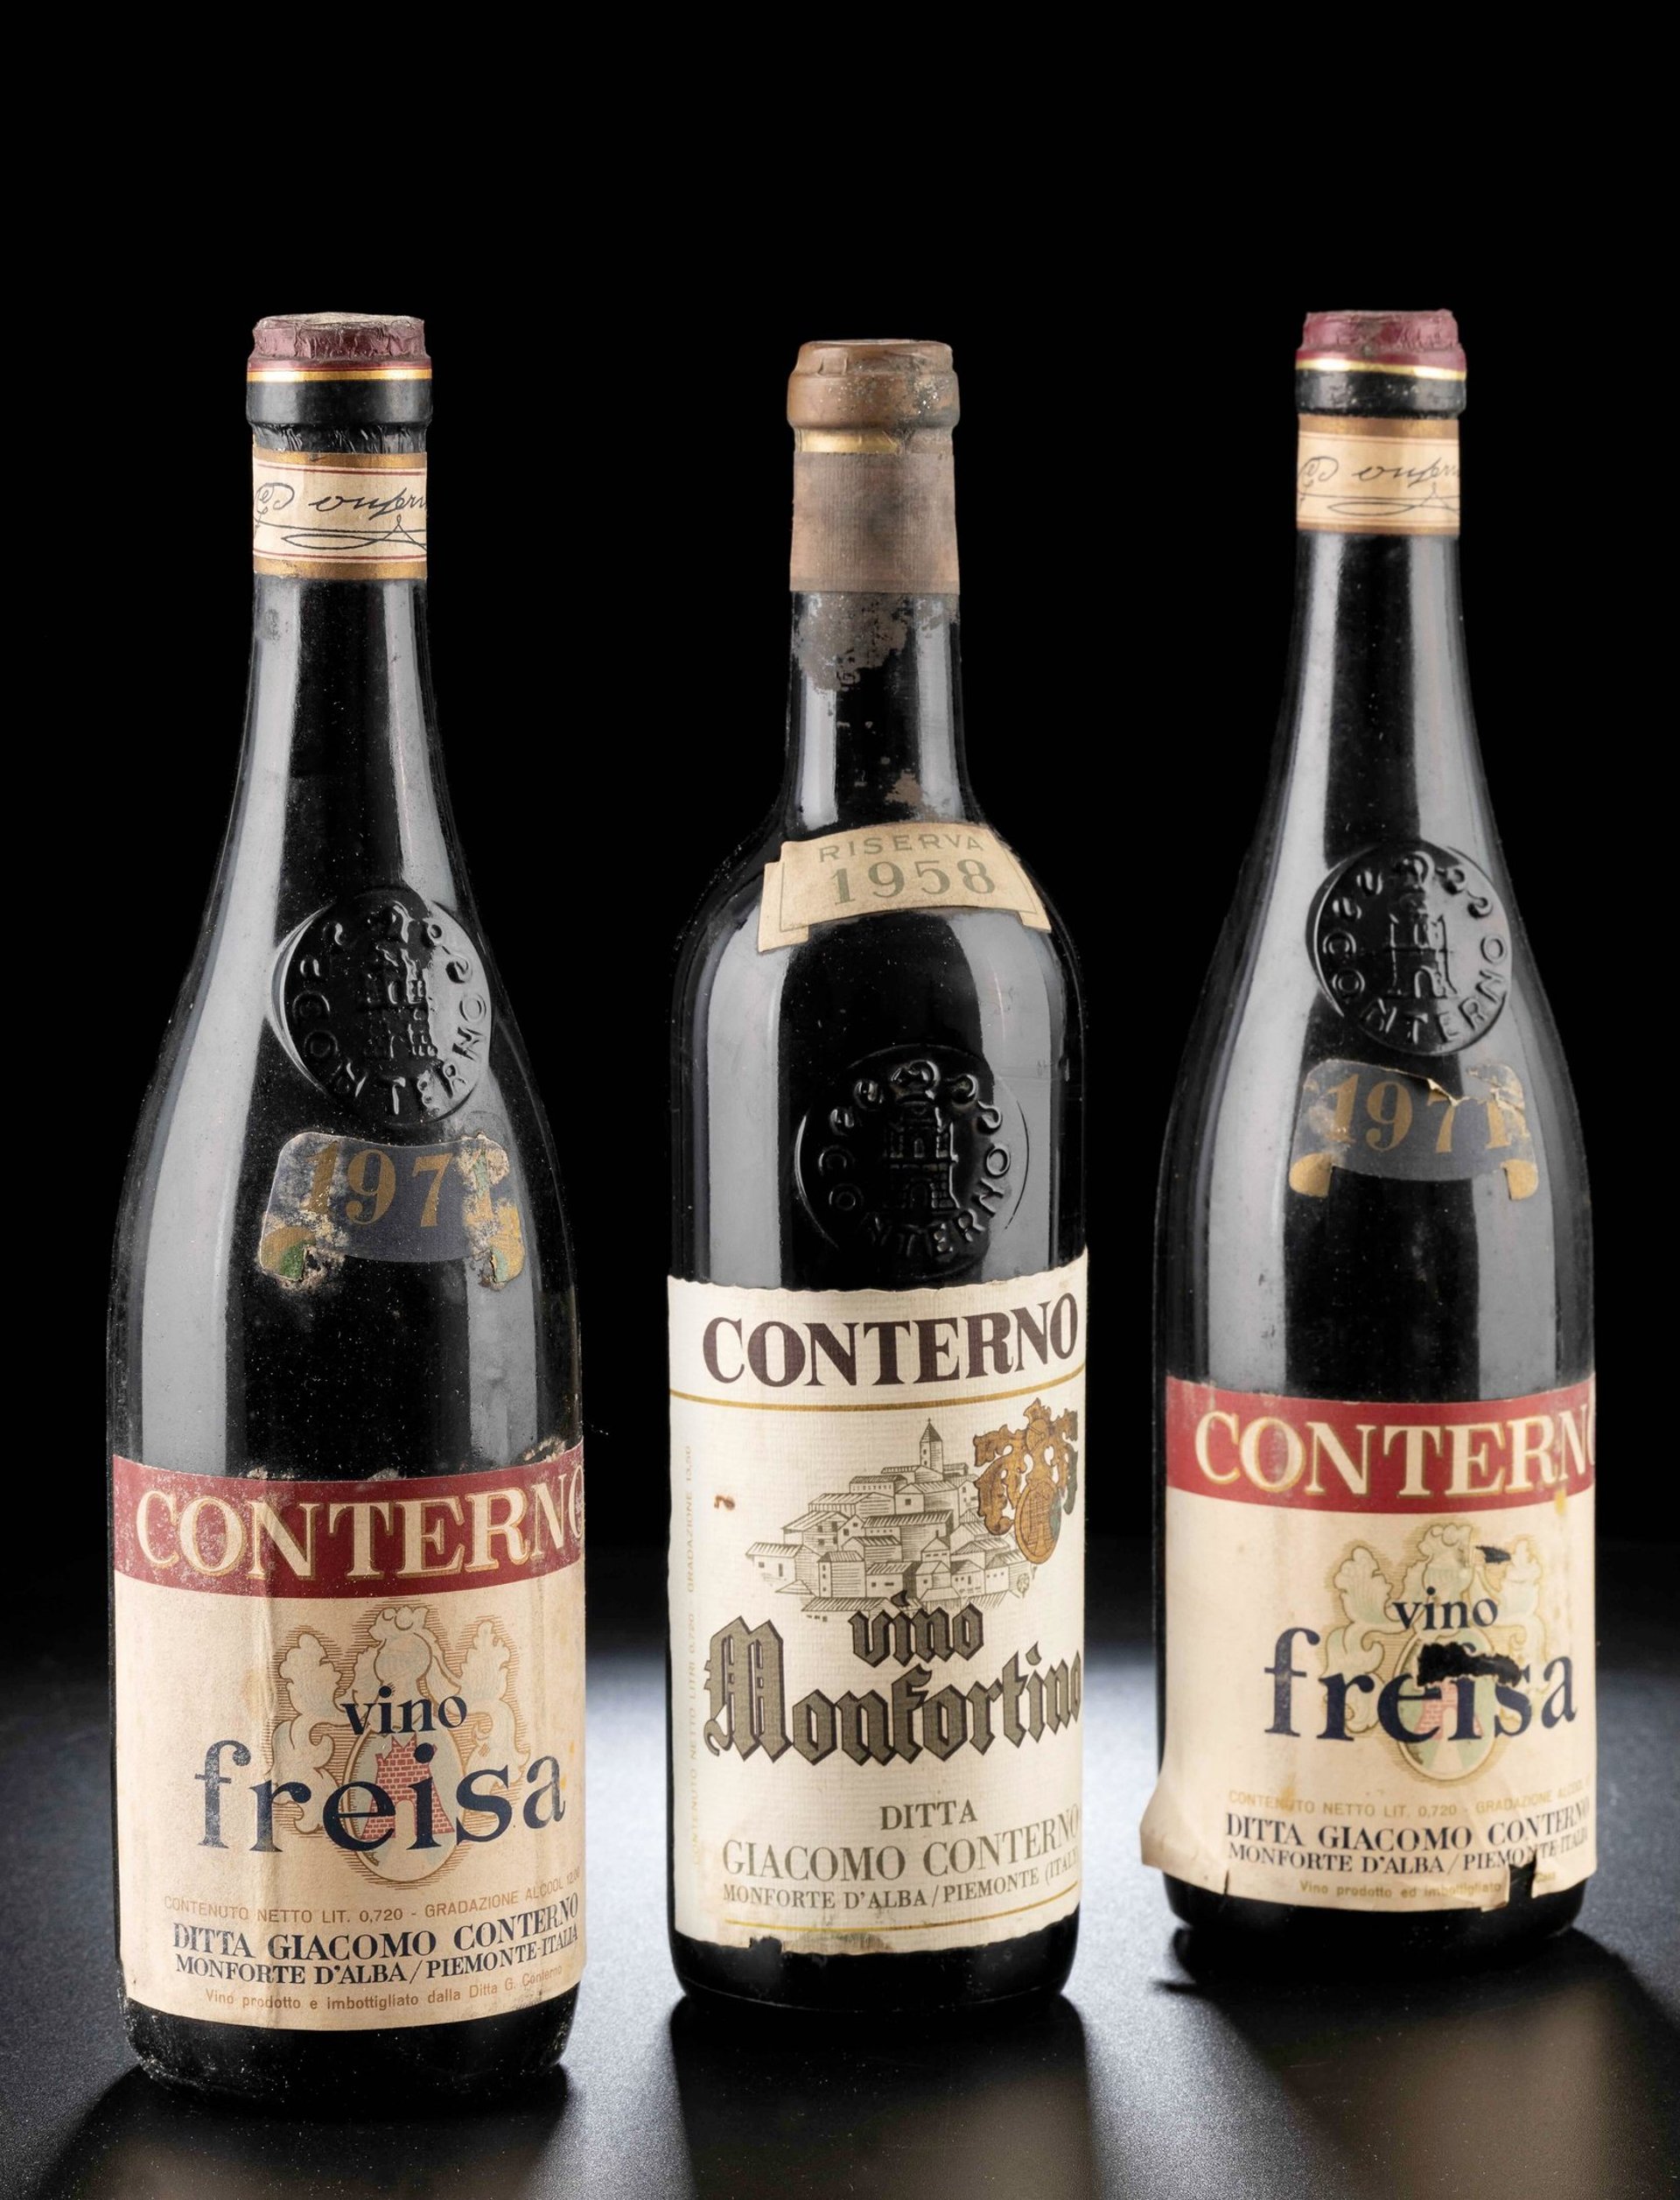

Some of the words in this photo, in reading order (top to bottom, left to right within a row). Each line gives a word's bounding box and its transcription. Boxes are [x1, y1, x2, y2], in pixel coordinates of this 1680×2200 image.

[819, 833, 984, 863] RISERVA
[831, 858, 996, 906] 1958
[701, 1292, 1079, 1388] CONTERNO
[847, 1589, 984, 1668] vino
[1391, 1586, 1499, 1631] vino
[340, 1685, 468, 1737] vino
[193, 1739, 566, 1853] freisa
[879, 1798, 978, 1831] DITTA
[1322, 1802, 1376, 1818] NETTO
[1383, 1804, 1411, 1818] LIT.
[1418, 1804, 1457, 1818] 0,720
[723, 1839, 906, 1882] GIACOMO
[922, 1803, 1080, 1877] CONTERNO
[1226, 1812, 1306, 1847] DITTA
[1318, 1825, 1473, 1853] GIACOMO
[1228, 1841, 1353, 1873] MONFORTE
[164, 1895, 249, 1921] CONTENUTO
[256, 1908, 312, 1923] NETTO
[321, 1909, 351, 1923] LIT.
[359, 1908, 403, 1924] 0,720
[424, 1890, 520, 1918] GRADAZIONE
[524, 1878, 564, 1902] ALCOOL
[724, 1883, 836, 1909] MONFORTE
[1298, 1880, 1329, 1895] Vino
[1336, 1884, 1392, 1899] prodotto
[1401, 1886, 1417, 1898] ed
[172, 1922, 256, 1959] DITTA
[267, 1930, 437, 1962] GIACOMO
[453, 1891, 579, 1951] CONTERNO
[175, 1952, 306, 1985] MONFORTE
[206, 1987, 234, 2005] Vino
[242, 1991, 301, 2010] prodotto
[309, 1998, 318, 2010] e
[327, 1993, 419, 2011] imbottigliato
[427, 1988, 461, 2004] dalla
[469, 1980, 498, 2000] Ditta
[504, 1977, 516, 1991] G.
[522, 1965, 563, 1987] Conterno
